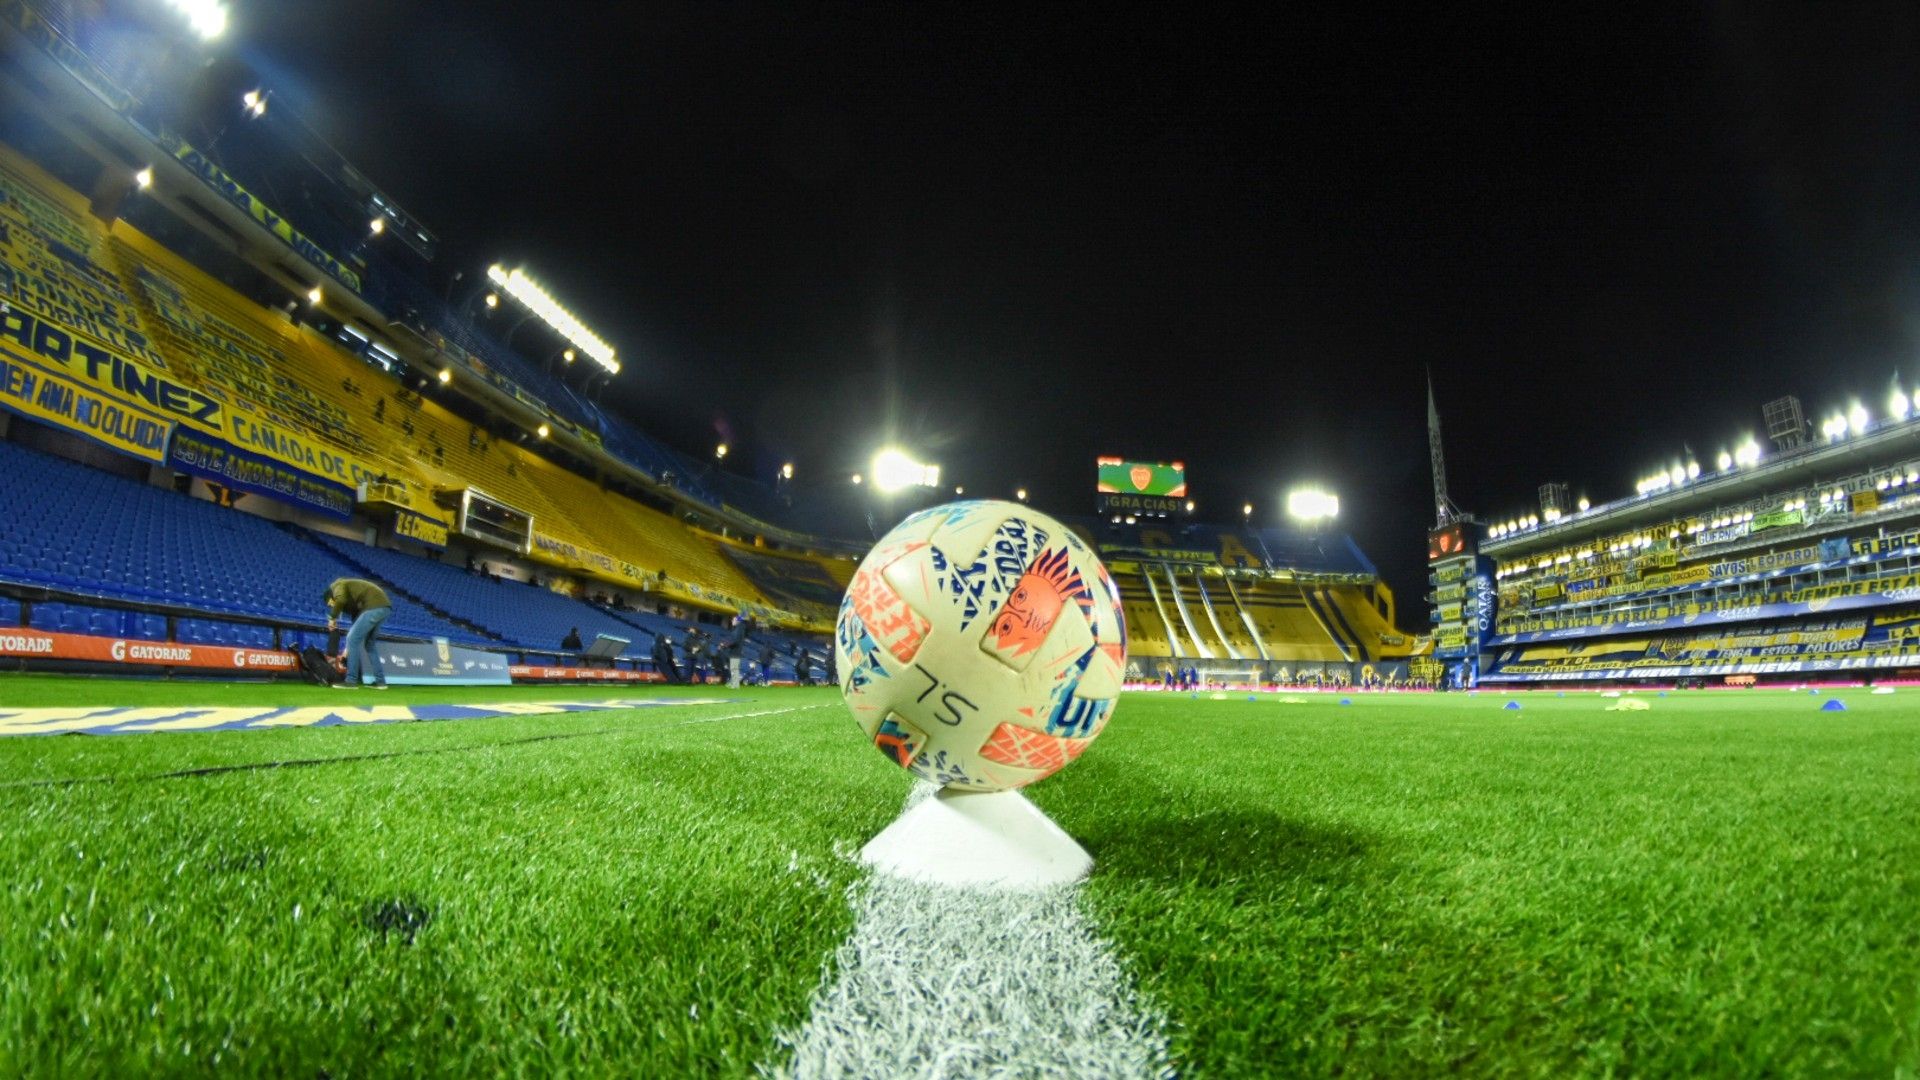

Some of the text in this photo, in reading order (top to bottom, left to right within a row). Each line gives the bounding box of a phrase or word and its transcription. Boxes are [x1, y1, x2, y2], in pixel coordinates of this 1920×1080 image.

[1878, 533, 1920, 551] BOC
[1868, 576, 1920, 594] ESTA
[1477, 575, 1489, 631] QATAR
[130, 645, 192, 660] GATORADE
[1737, 661, 1802, 673] NUEVA
